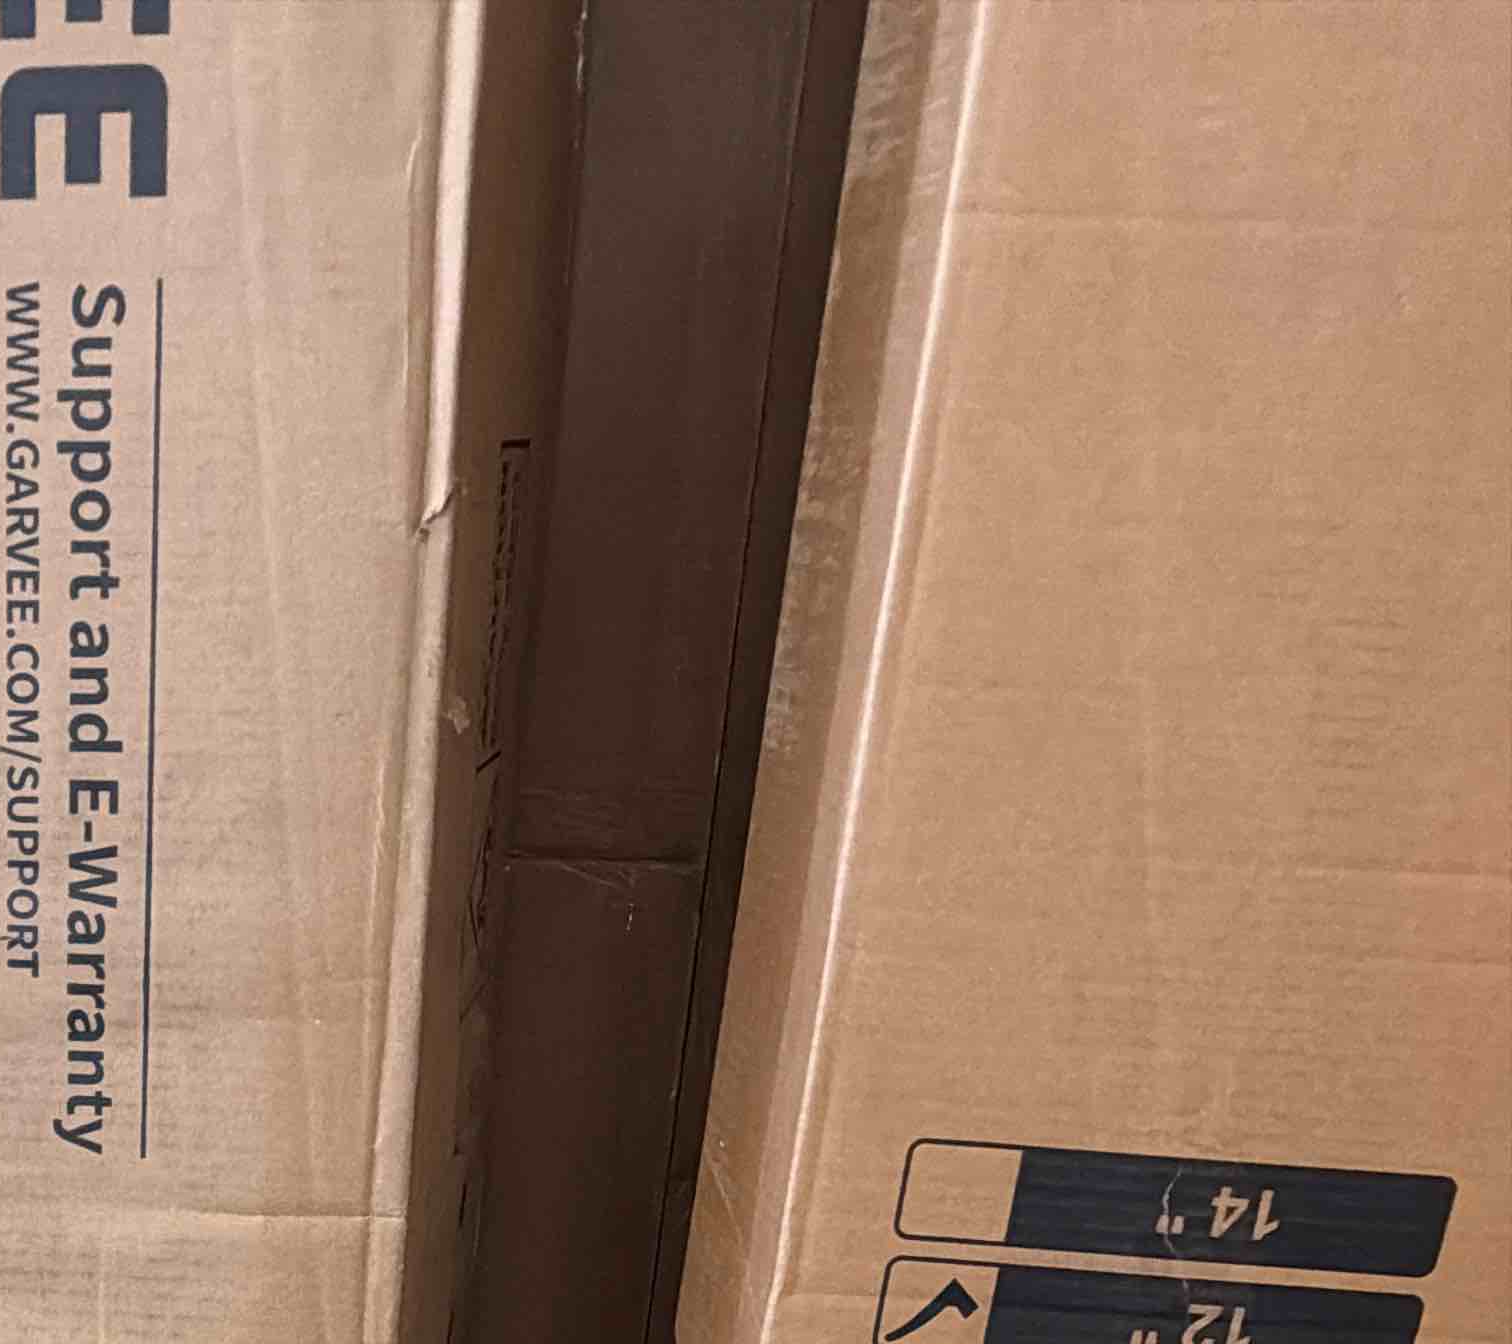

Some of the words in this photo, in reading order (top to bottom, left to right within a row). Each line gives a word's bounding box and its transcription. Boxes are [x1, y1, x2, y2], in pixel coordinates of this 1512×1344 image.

[57, 282, 125, 600] Support
[4, 283, 41, 978] WWW.GARVEE.COM/SUPPORT
[67, 617, 124, 754] and
[53, 776, 120, 1156] E-Warranty
